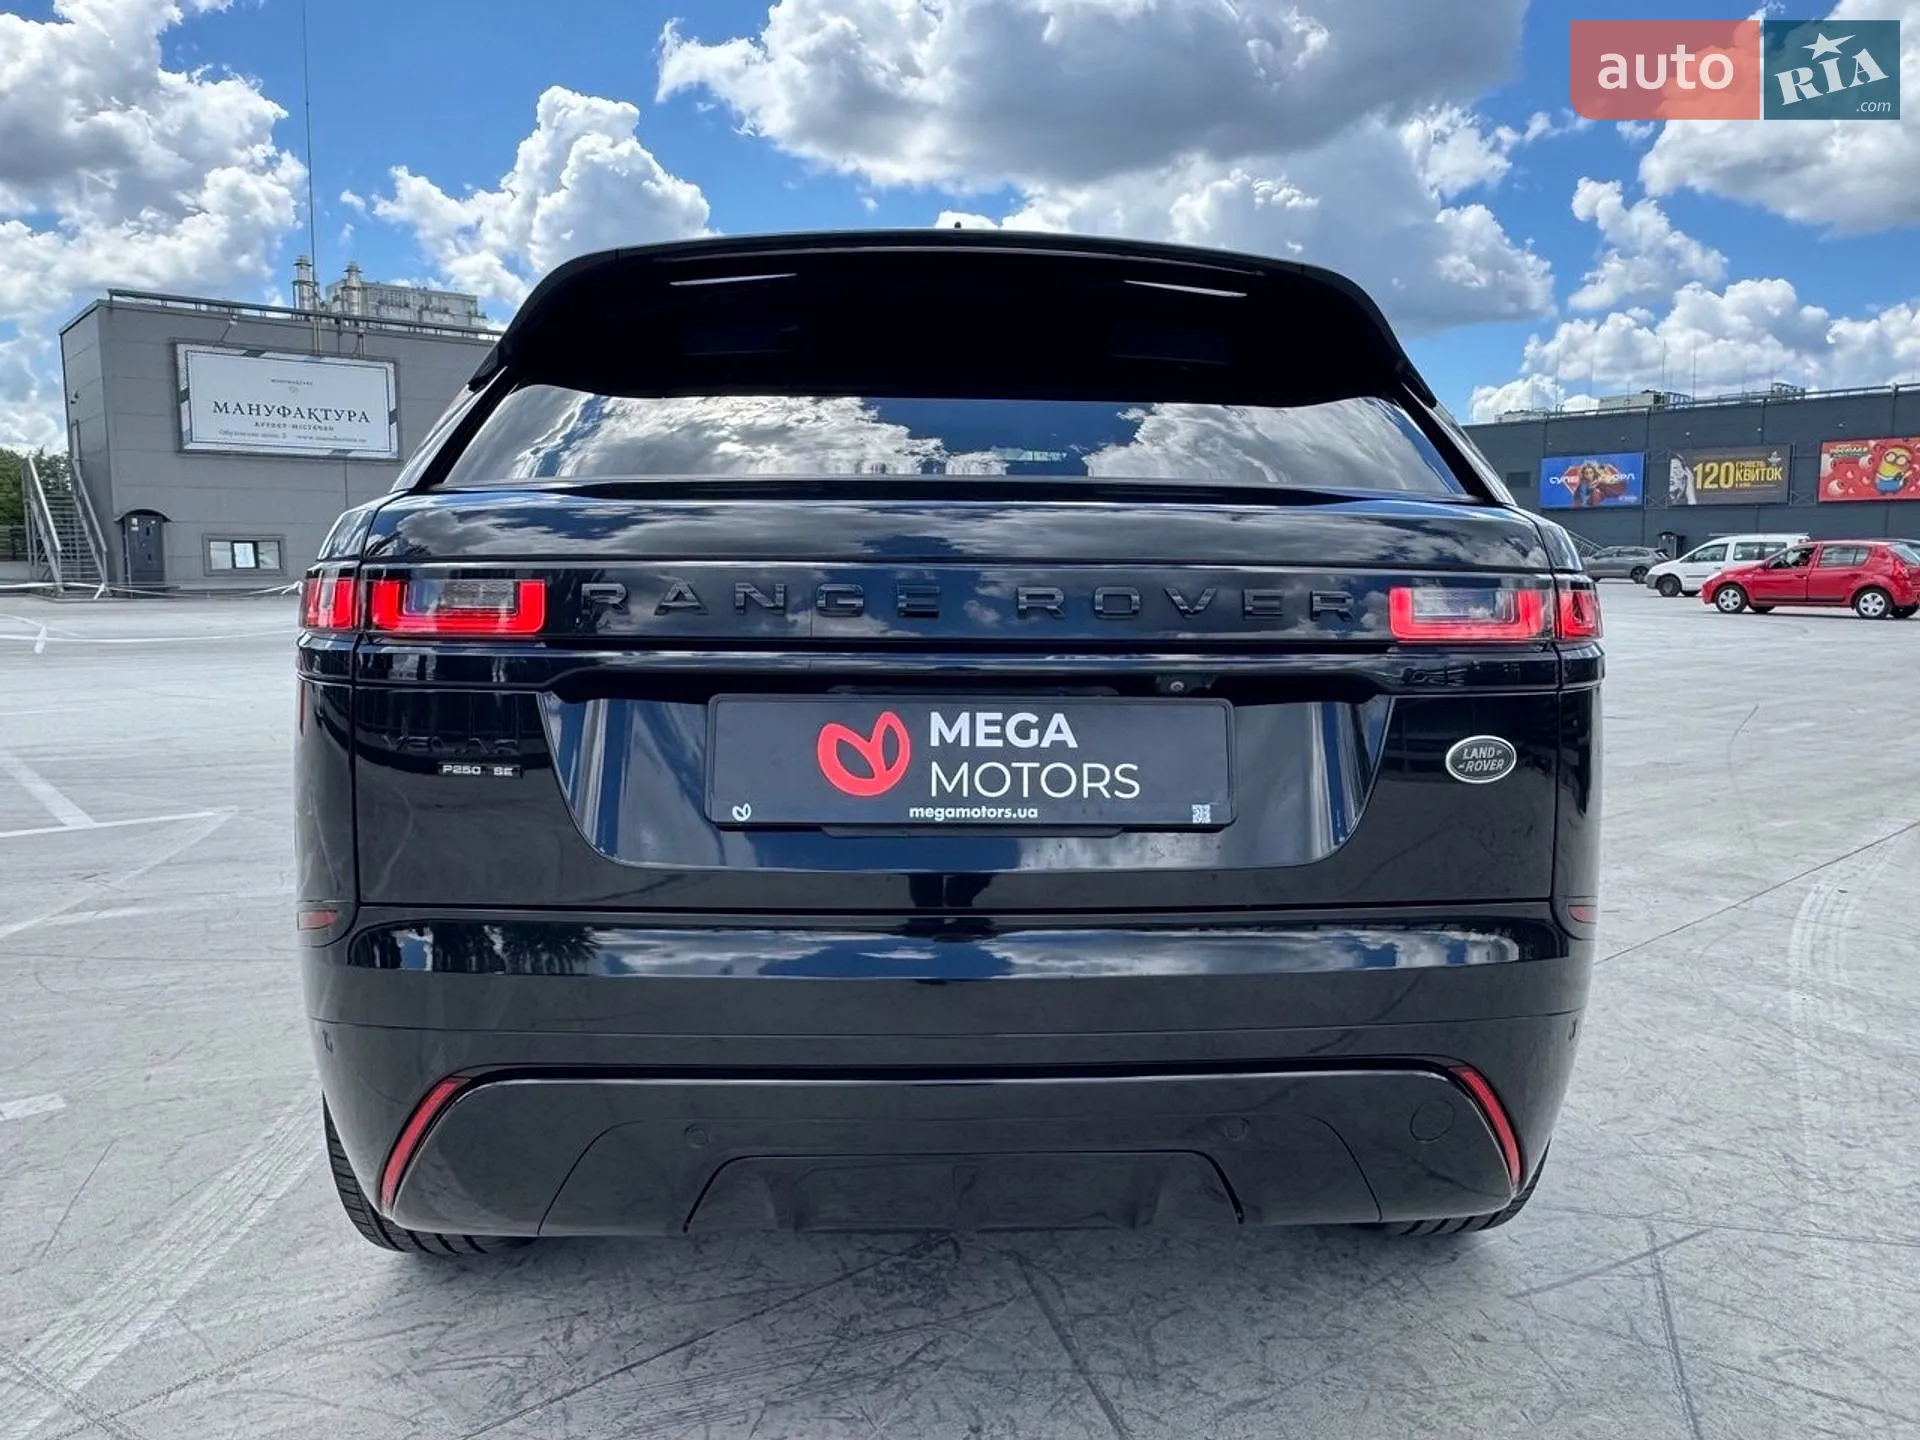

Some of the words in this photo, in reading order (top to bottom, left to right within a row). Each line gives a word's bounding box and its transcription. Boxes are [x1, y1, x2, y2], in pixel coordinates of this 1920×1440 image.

[212, 400, 371, 424] МАНУФАКТУРА
[1693, 461, 1736, 489] 120
[1735, 466, 1783, 482] КВИТОК
[580, 582, 940, 618] RANGE
[1016, 586, 1356, 622] ROVER
[930, 712, 1078, 749] MEGA
[1462, 747, 1495, 760] LAND
[442, 765, 481, 775] P250
[493, 767, 513, 776] SE
[1464, 758, 1504, 772] ROVER
[930, 762, 1140, 799] MOTORS
[909, 805, 1038, 821] megamotors.ua
